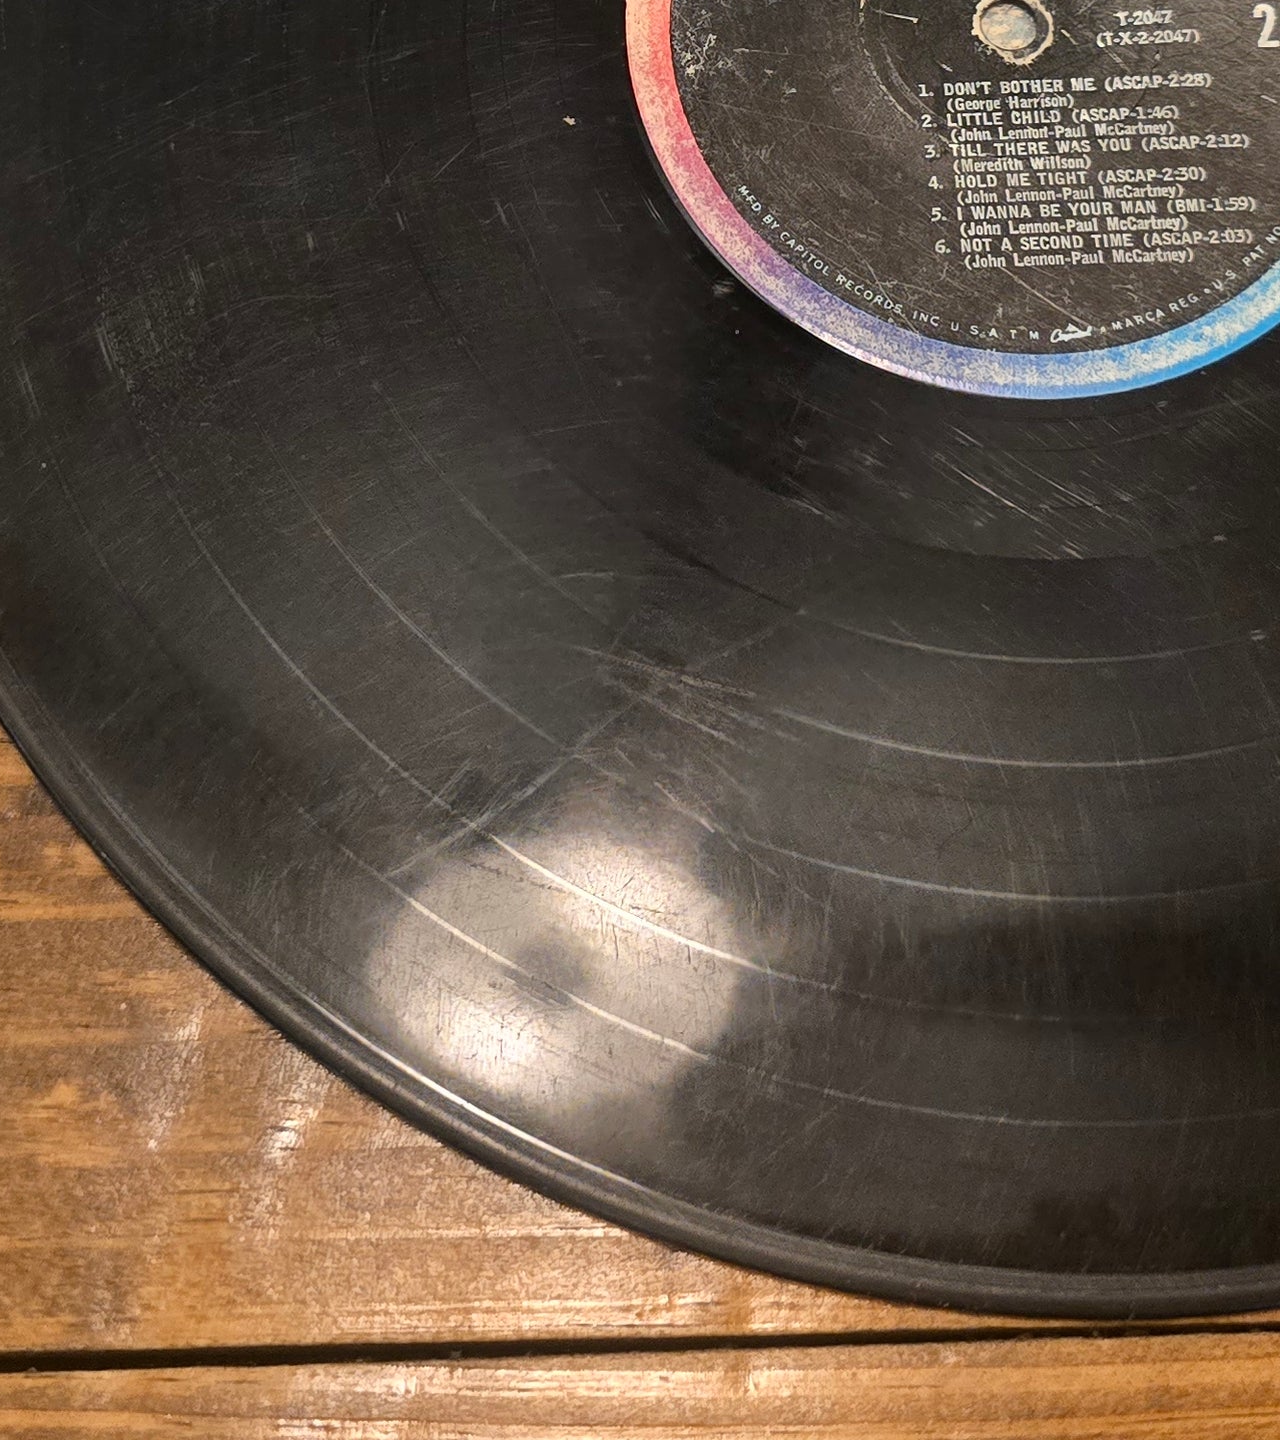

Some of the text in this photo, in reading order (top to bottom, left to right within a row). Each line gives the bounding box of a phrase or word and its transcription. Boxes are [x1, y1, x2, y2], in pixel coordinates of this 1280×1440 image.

[1113, 10, 1174, 26] T-2047
[1096, 29, 1201, 47] (T-X-2-2047)
[919, 83, 935, 98] 1.
[944, 82, 991, 97] DON'T
[1000, 79, 1064, 94] BOTHER
[1070, 77, 1097, 92] ME
[947, 93, 1075, 112] (George Harrison)
[921, 105, 1180, 128] 2. LITTLE CHILD (ASCAP-1:46)
[951, 120, 1175, 143] (John Lennon-Paul McCartney)
[924, 134, 1251, 159] 3. TILL THERE WAS YOU (ASCAP-2:12)
[953, 154, 1092, 174] (Meredith Willson)
[928, 166, 1207, 190] 4. HOLD ME TIGHT (ASCAP-2:30)
[957, 183, 1184, 206] (John Lennon-Paul McCartney)
[931, 207, 948, 222] 5.
[956, 207, 963, 221] I
[971, 204, 1032, 220] WANNA
[1040, 203, 1062, 217] BE
[1068, 201, 1113, 216] YOUR
[1121, 200, 1157, 215] MAN
[960, 214, 1189, 238] (John Lennon-Paul McCartney)
[763, 214, 780, 229] BY
[780, 231, 830, 276] CAPITOL
[935, 230, 1254, 254] 6. NOT A SECOND TIME (ASCAP-2:03)
[964, 247, 1194, 271] (John Lennon-Paul McCartney)
[1112, 308, 1166, 331] MARCA
